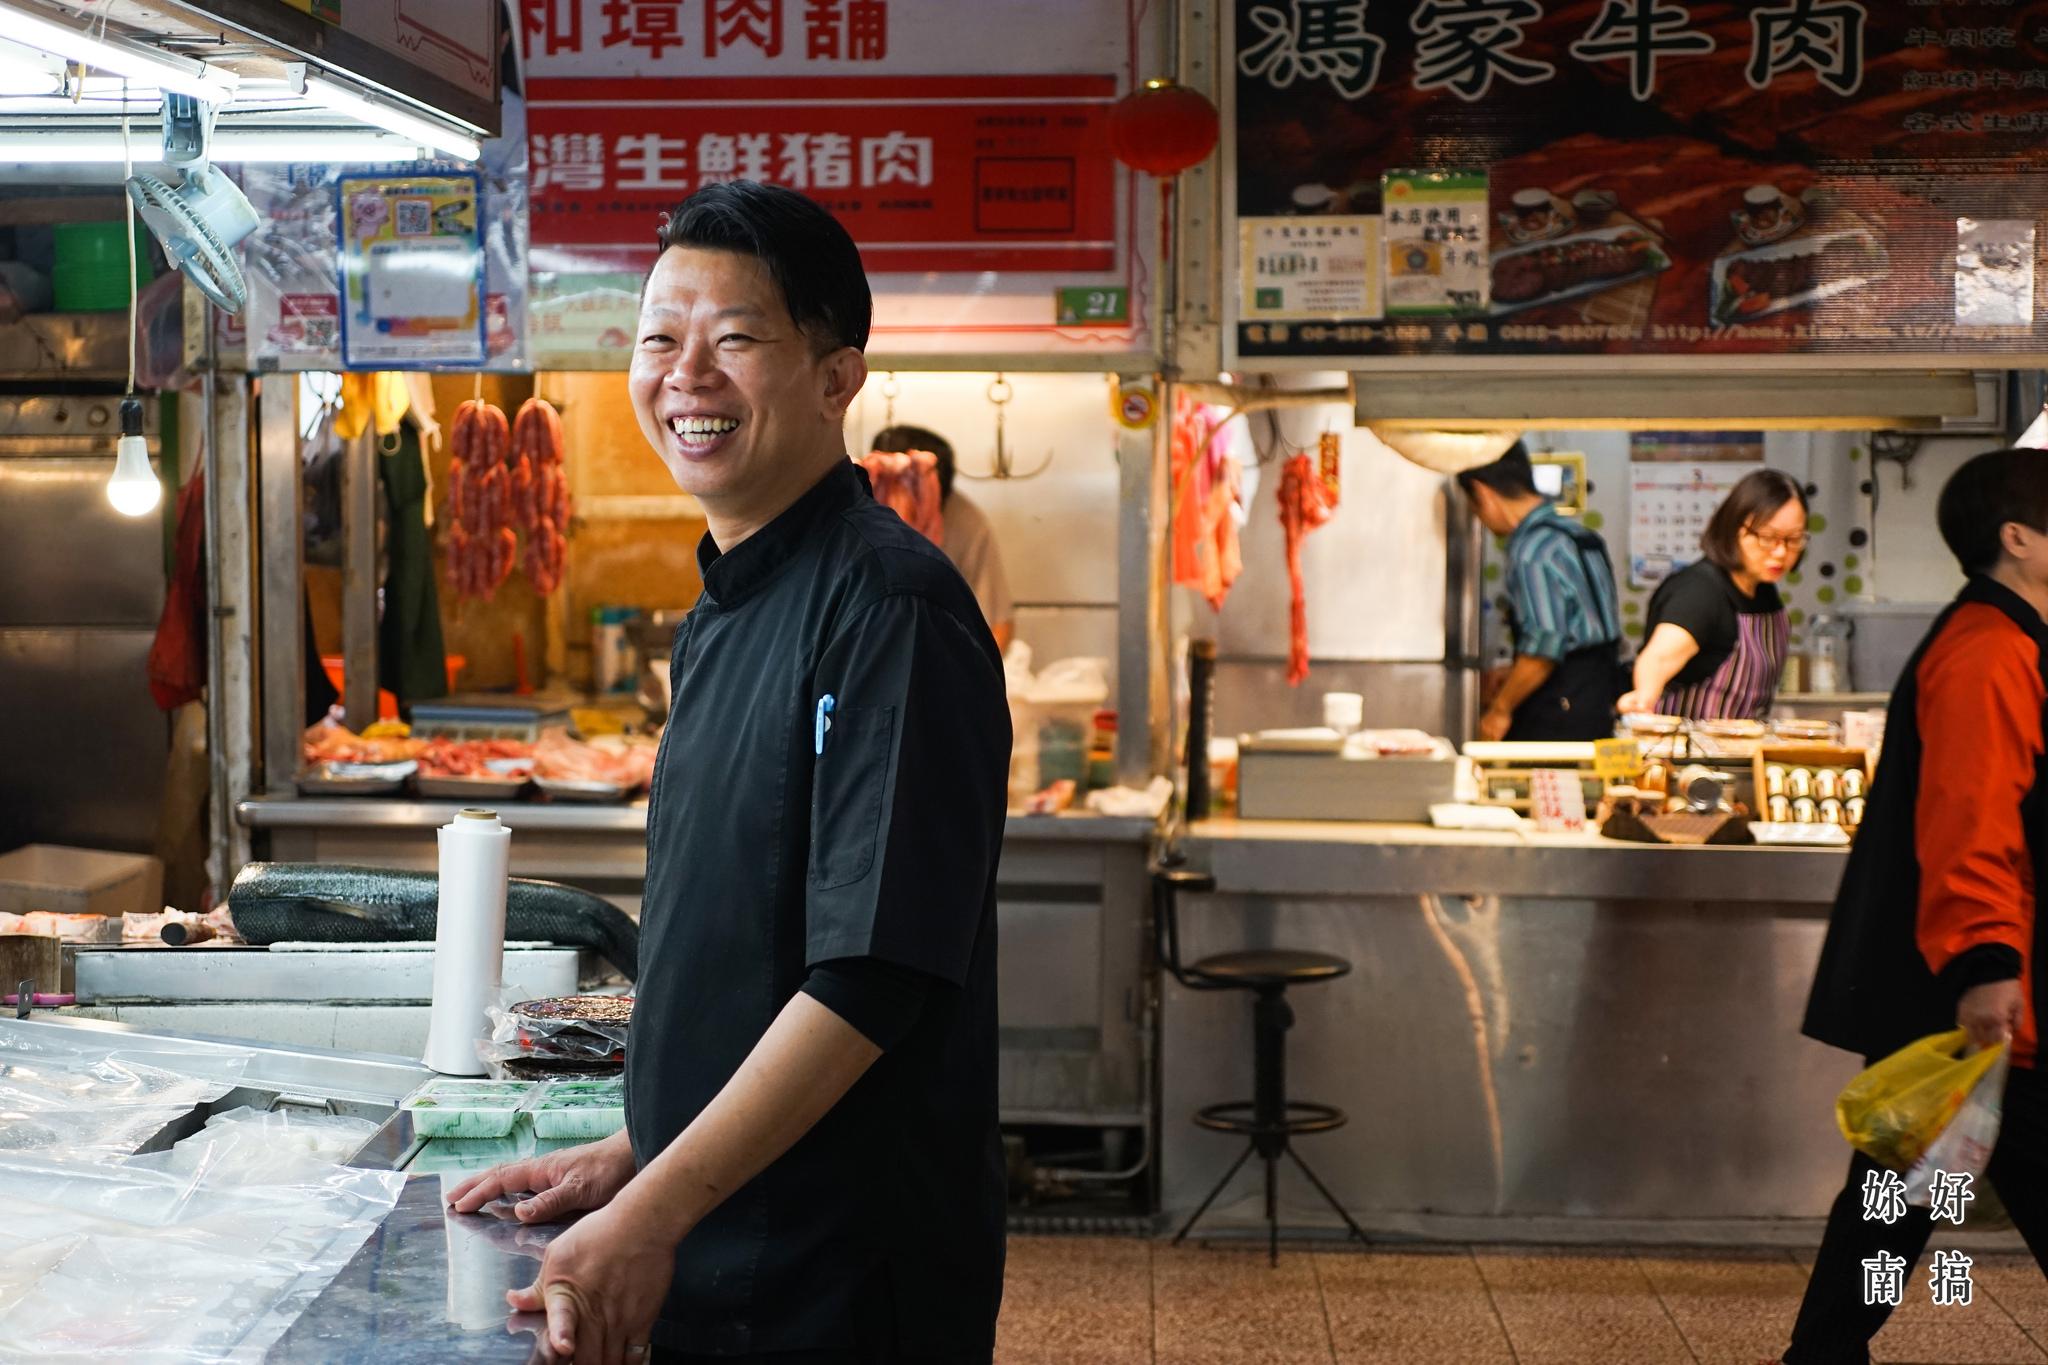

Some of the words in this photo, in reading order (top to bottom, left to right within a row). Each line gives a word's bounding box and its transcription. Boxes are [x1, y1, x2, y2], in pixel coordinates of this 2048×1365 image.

[1239, 0, 1868, 101] 馮家牛肉
[1085, 291, 1118, 316] 21
